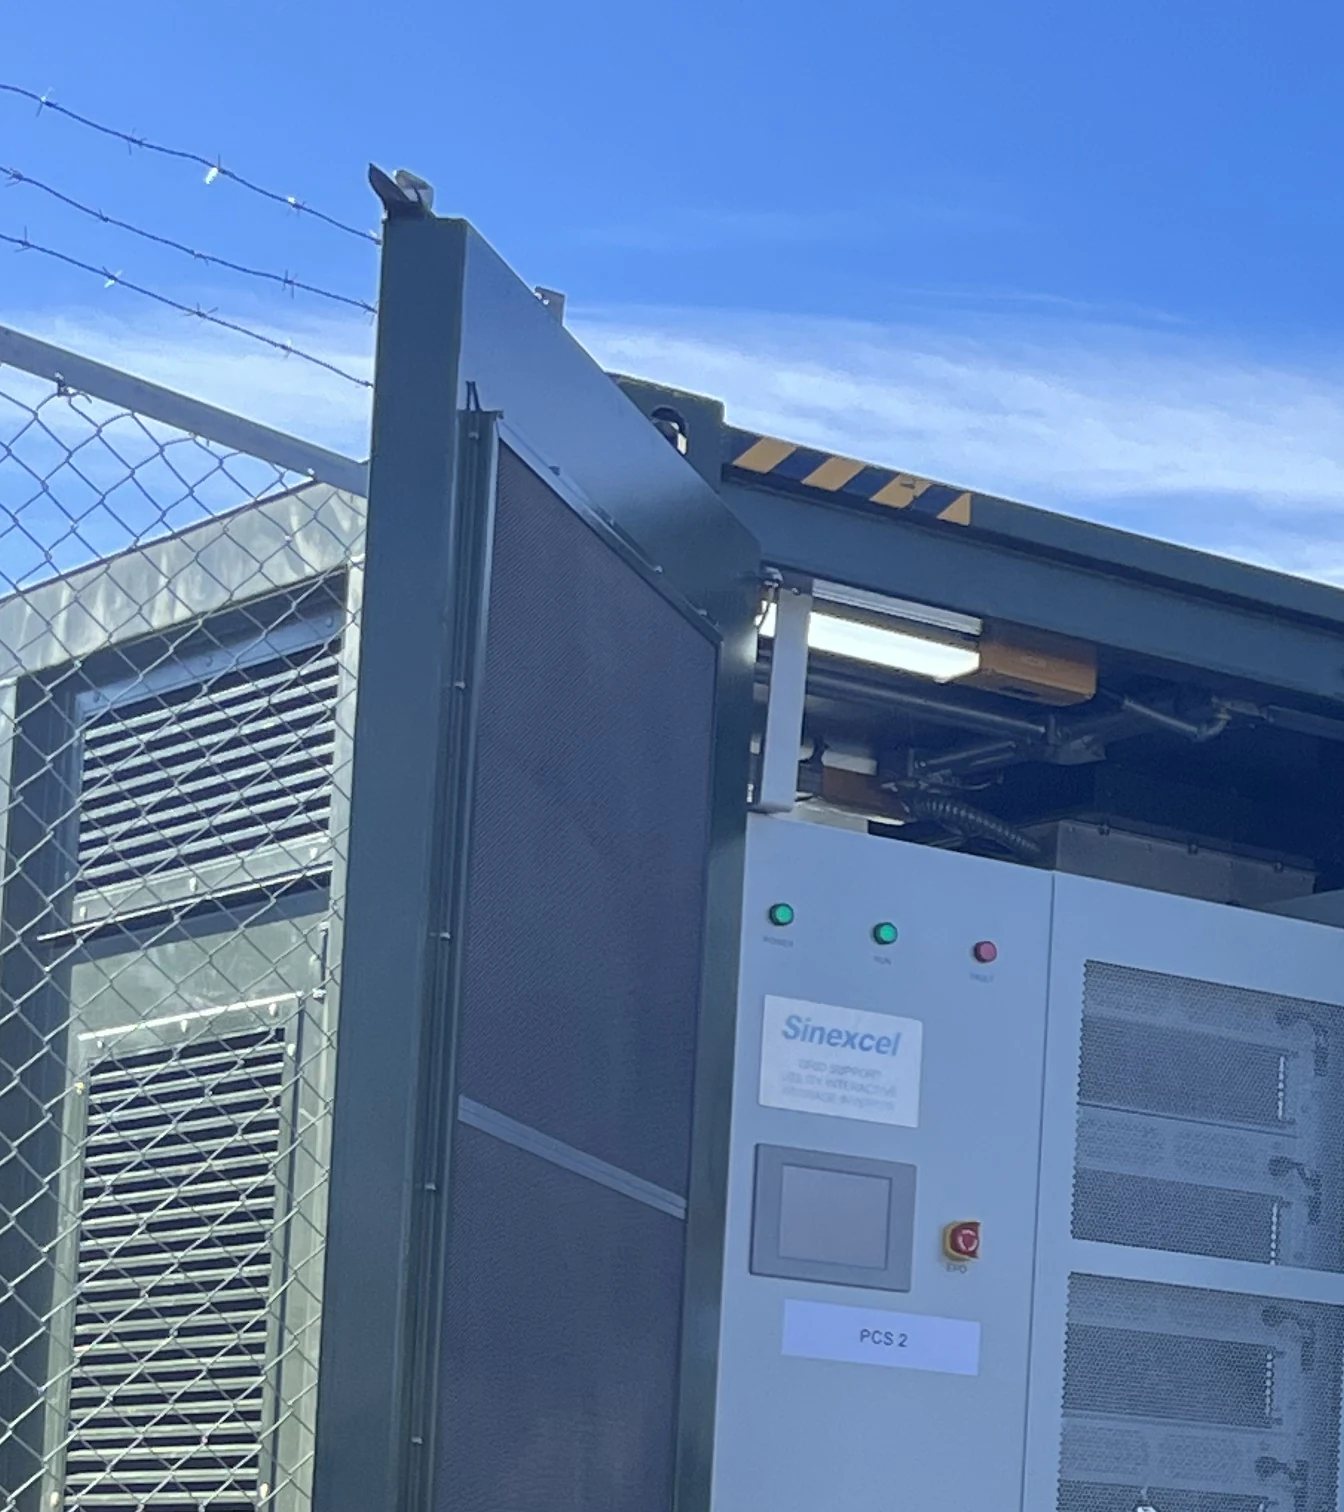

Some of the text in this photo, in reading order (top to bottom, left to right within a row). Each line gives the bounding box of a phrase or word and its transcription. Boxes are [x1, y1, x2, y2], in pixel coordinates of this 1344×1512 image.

[782, 1014, 902, 1057] Sinexcel
[860, 1328, 908, 1348] PCS 2
